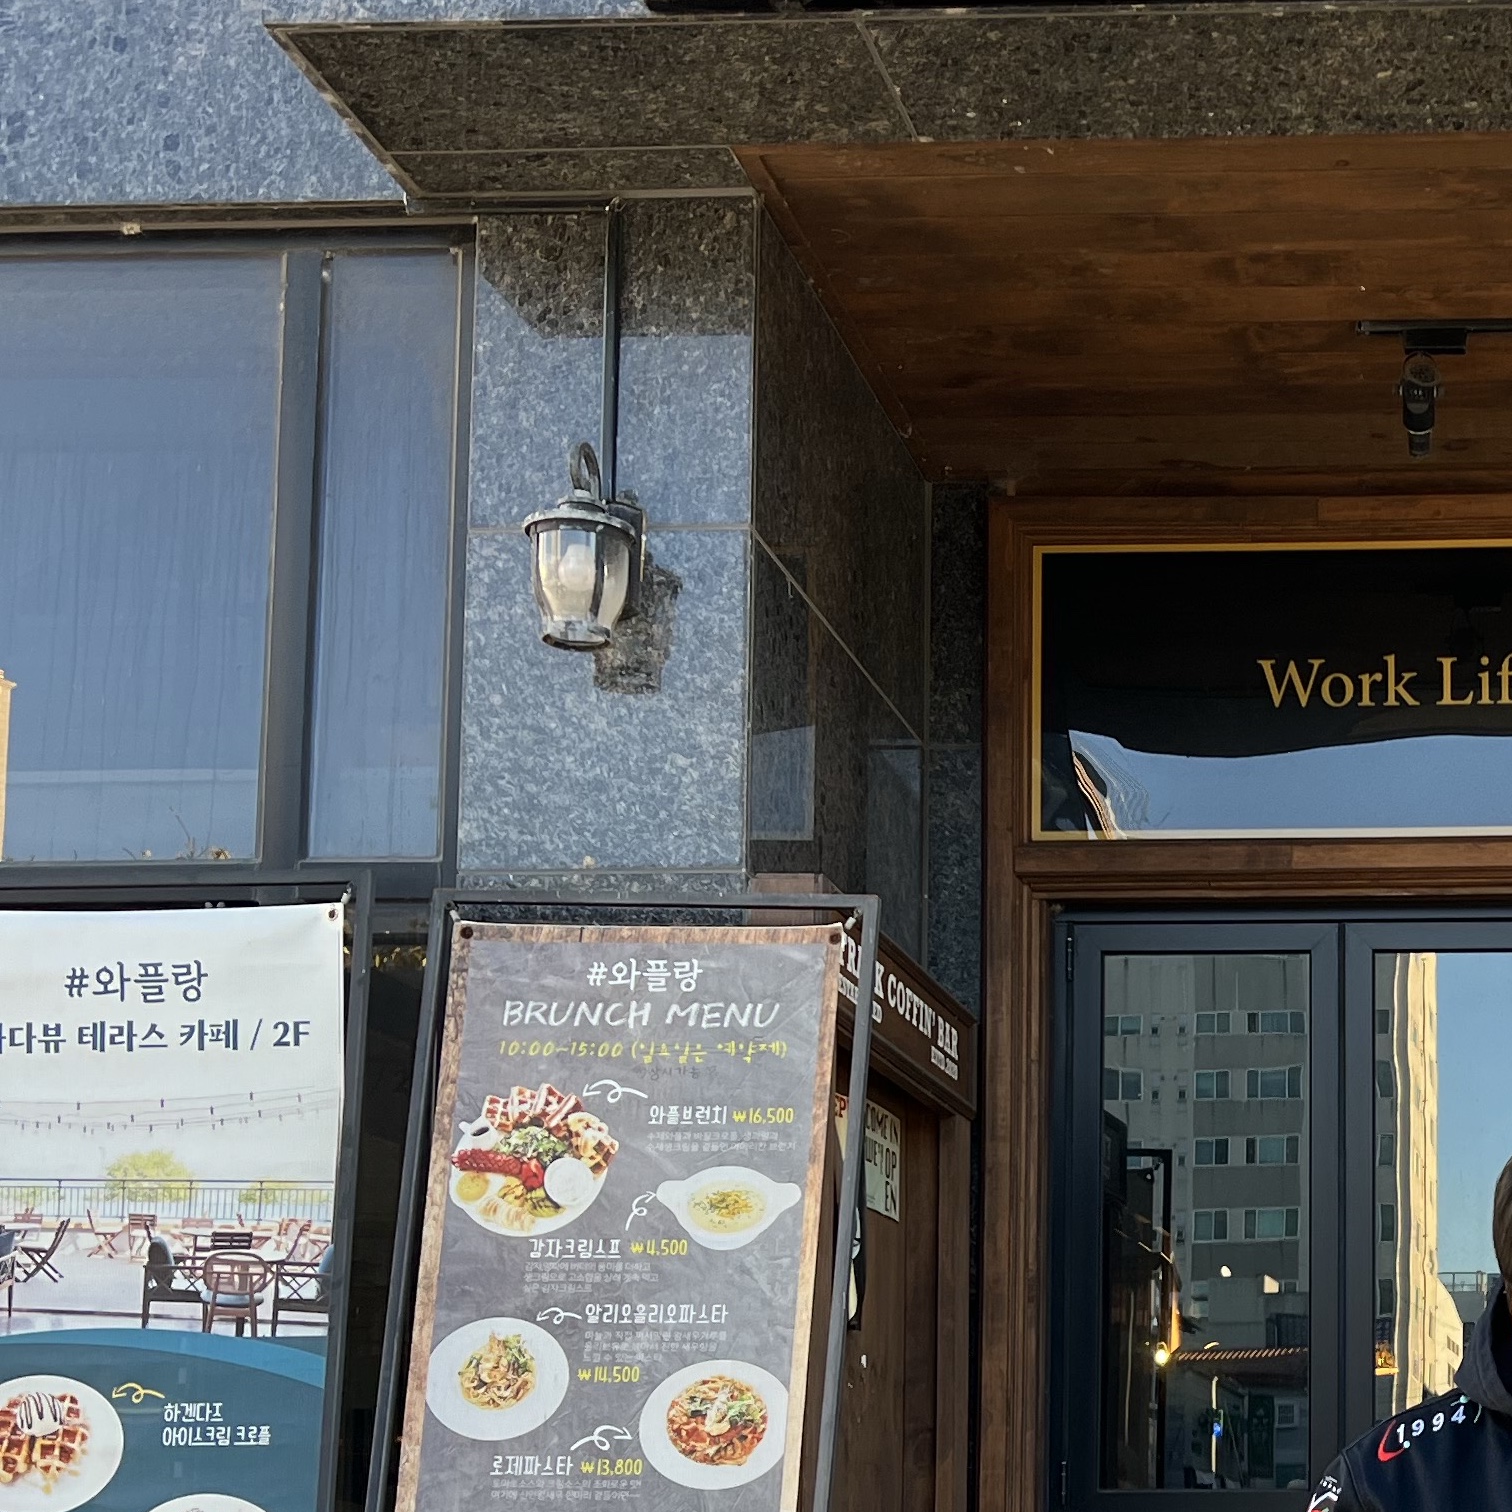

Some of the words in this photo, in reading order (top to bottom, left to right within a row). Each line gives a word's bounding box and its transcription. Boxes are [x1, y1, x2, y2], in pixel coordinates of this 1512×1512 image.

[1256, 654, 1420, 708] Work
[64, 959, 209, 1003] #와플랑
[586, 957, 703, 992] #와플랑
[840, 931, 885, 1000] FRK
[937, 1015, 959, 1061] BAR
[501, 1001, 651, 1029] BRUNCH
[665, 1002, 780, 1029] MENU
[77, 1019, 168, 1052] 테라스
[179, 1018, 239, 1051] 카페
[272, 1020, 311, 1048] 2F
[648, 1105, 728, 1125] 와플브런치
[529, 1238, 622, 1259] 감자크림스프
[585, 1303, 729, 1325] 알리오올리오파스타
[163, 1402, 224, 1422] 하겐다즈
[1396, 1404, 1467, 1444] 1994
[162, 1427, 231, 1447] 아이스크림
[233, 1425, 271, 1446] 크로플
[490, 1455, 574, 1476] 로제파스타
